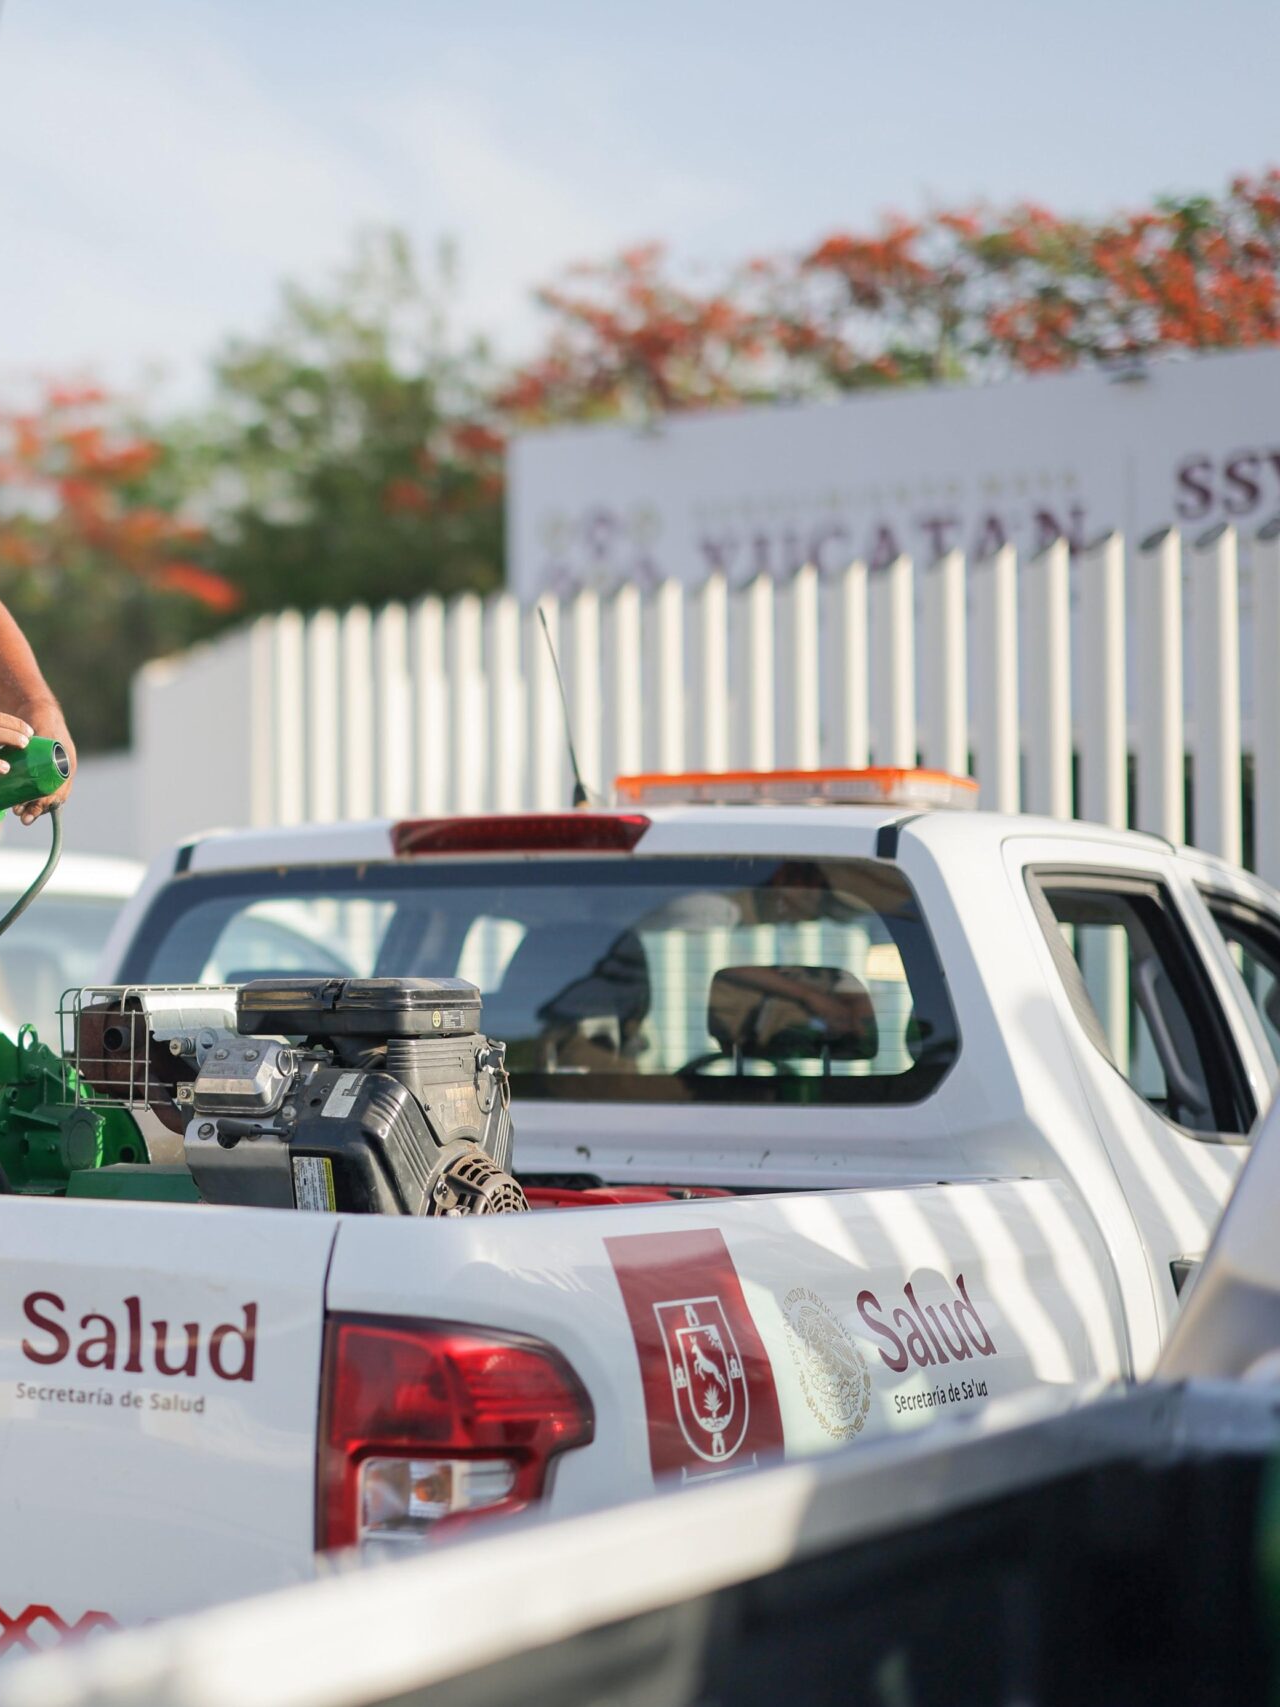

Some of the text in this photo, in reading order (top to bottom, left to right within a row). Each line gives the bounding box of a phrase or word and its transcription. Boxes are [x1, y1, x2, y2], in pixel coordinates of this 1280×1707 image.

[21, 1291, 258, 1382] Salud
[855, 1273, 998, 1373] Salud
[16, 1383, 206, 1414] Secretaría de Salud
[894, 1385, 947, 1414] Secretaría
[948, 1384, 962, 1403] de
